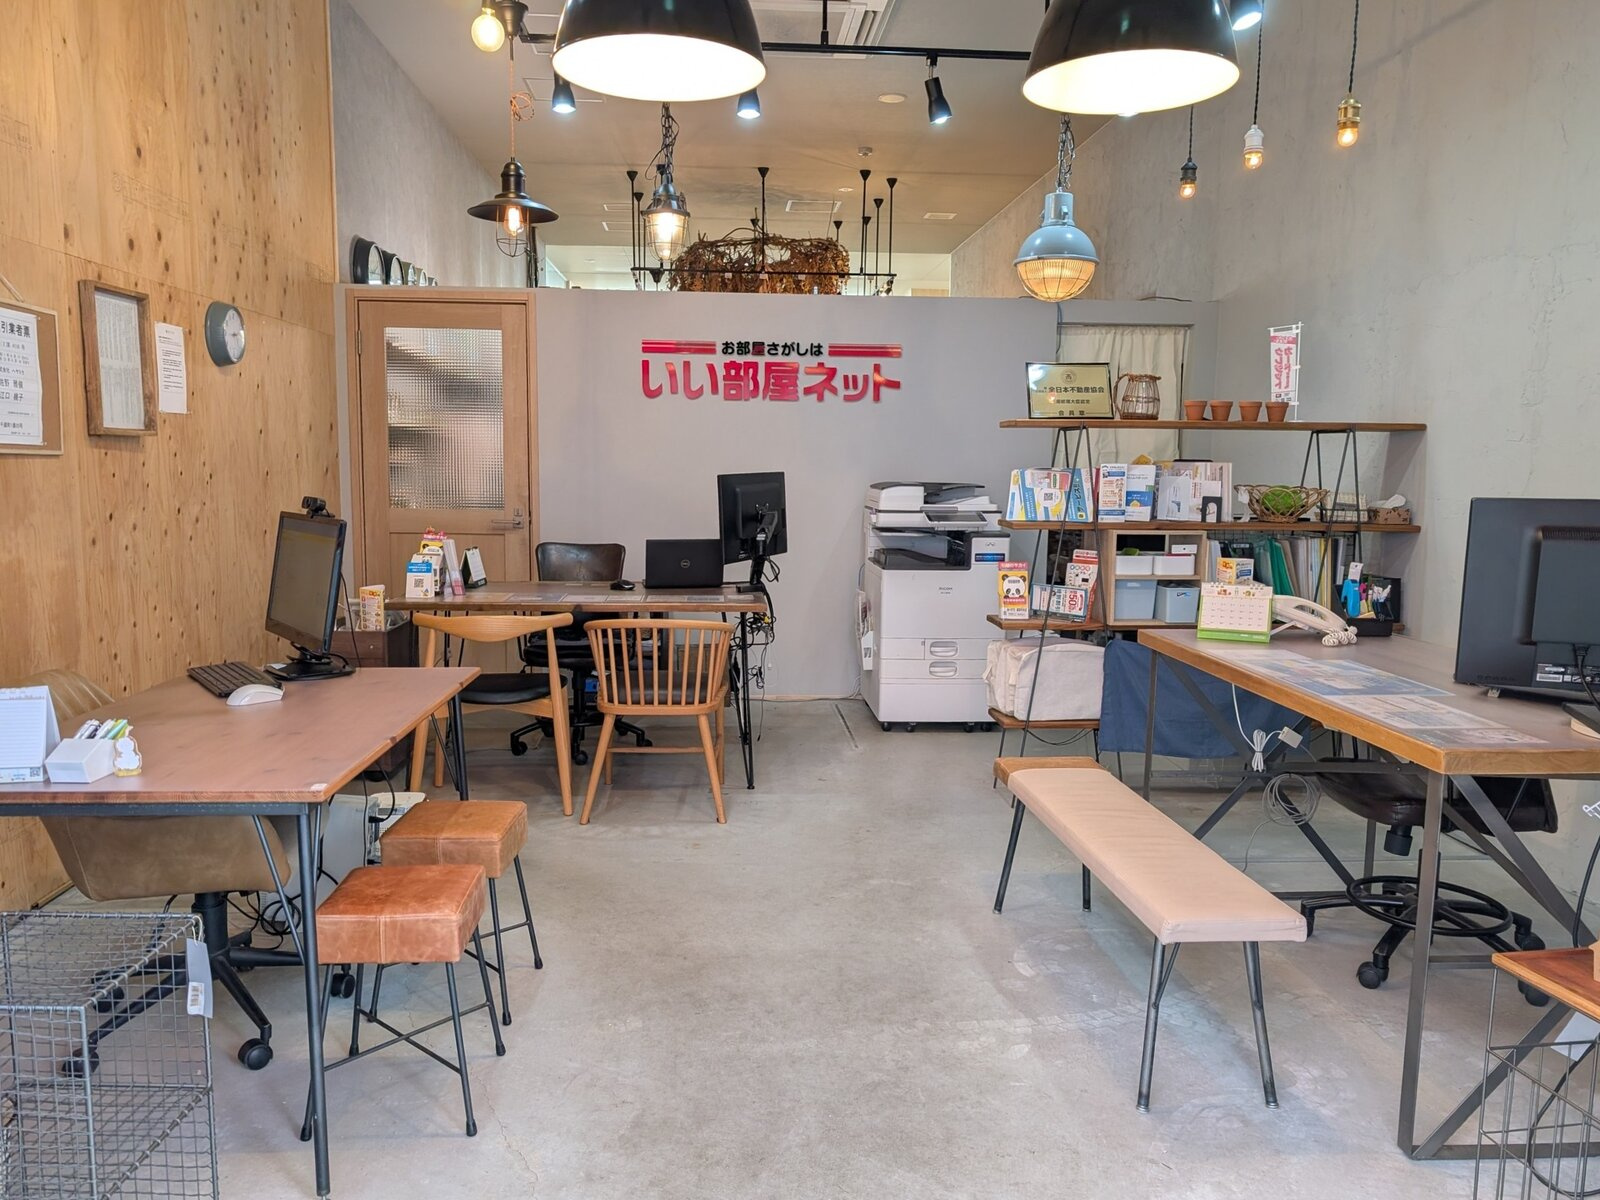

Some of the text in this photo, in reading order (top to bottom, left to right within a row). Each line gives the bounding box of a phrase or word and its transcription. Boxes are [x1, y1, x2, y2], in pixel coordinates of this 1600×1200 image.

[721, 341, 823, 356] お部屋さがしは
[641, 359, 901, 403] いい部屋ネット
[1048, 386, 1105, 394] 全日本不動産協会
